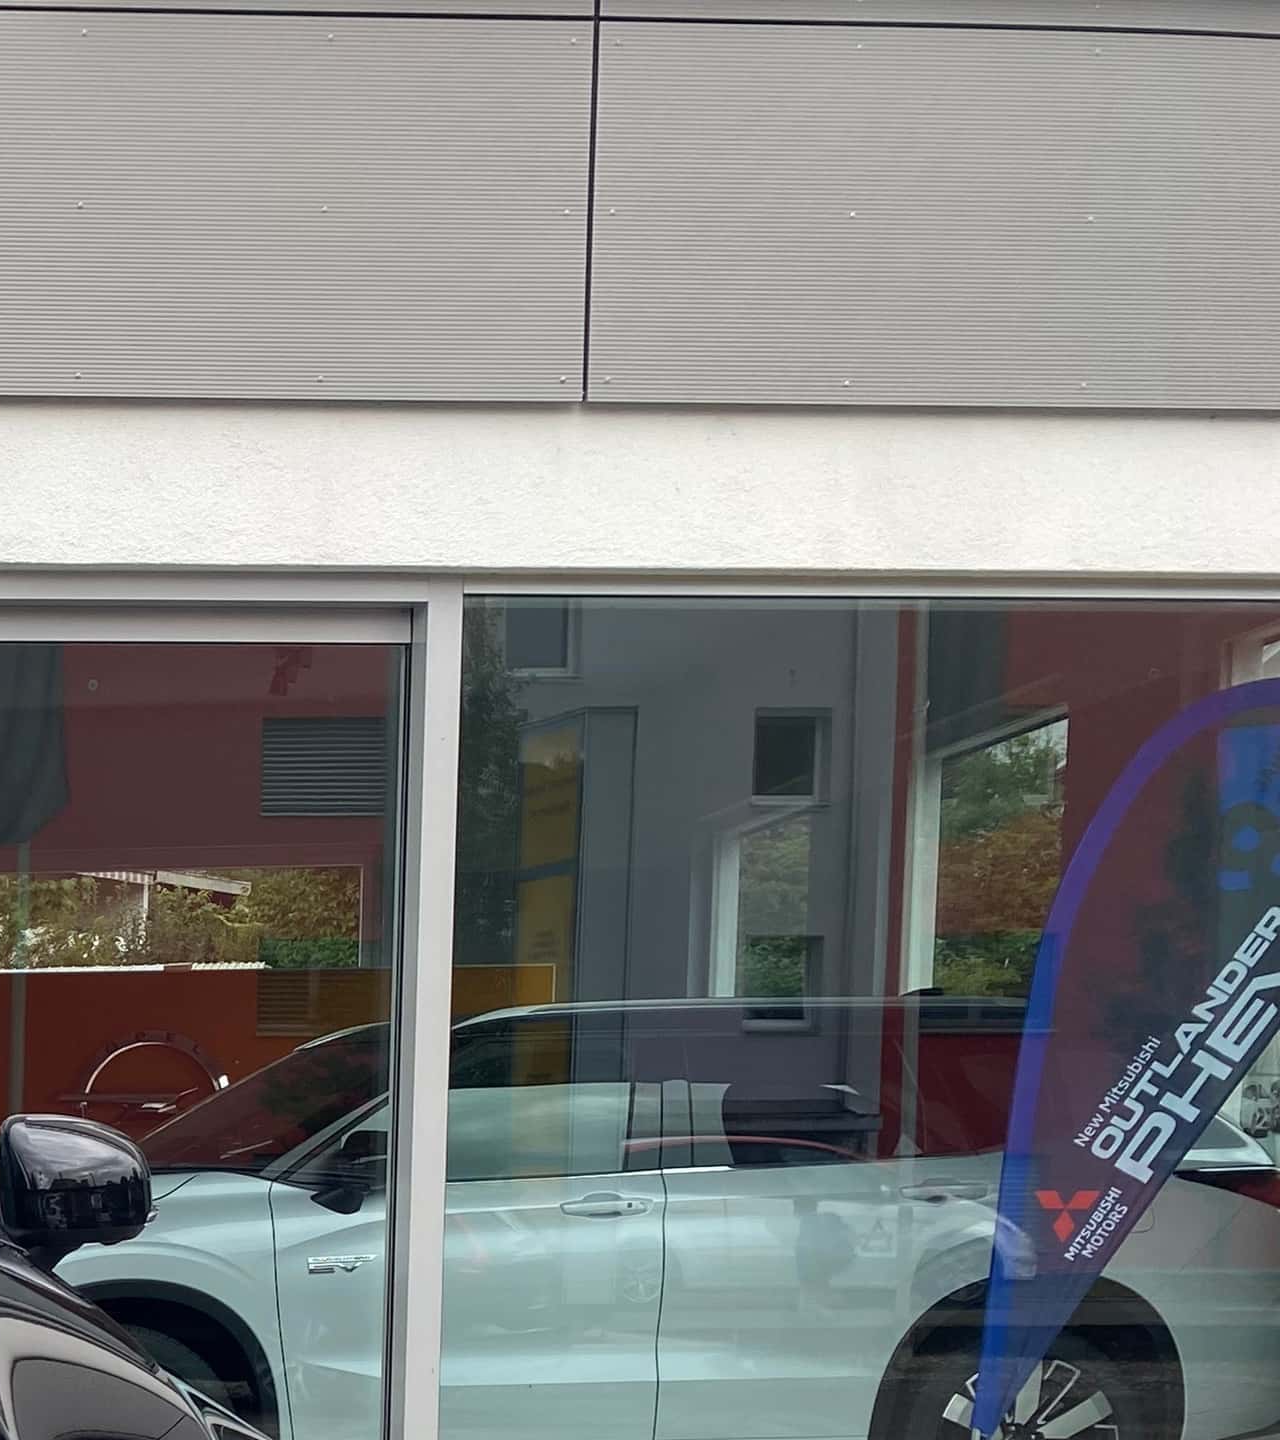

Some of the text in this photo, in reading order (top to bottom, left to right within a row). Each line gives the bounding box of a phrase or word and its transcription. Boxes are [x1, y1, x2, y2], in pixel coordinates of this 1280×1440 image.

[1091, 906, 1280, 1159] OUTLANDER
[1073, 1035, 1161, 1147] New Mitsubishi
[1063, 1186, 1123, 1261] MITSUBISHI
[1081, 1203, 1129, 1258] MOTORS
